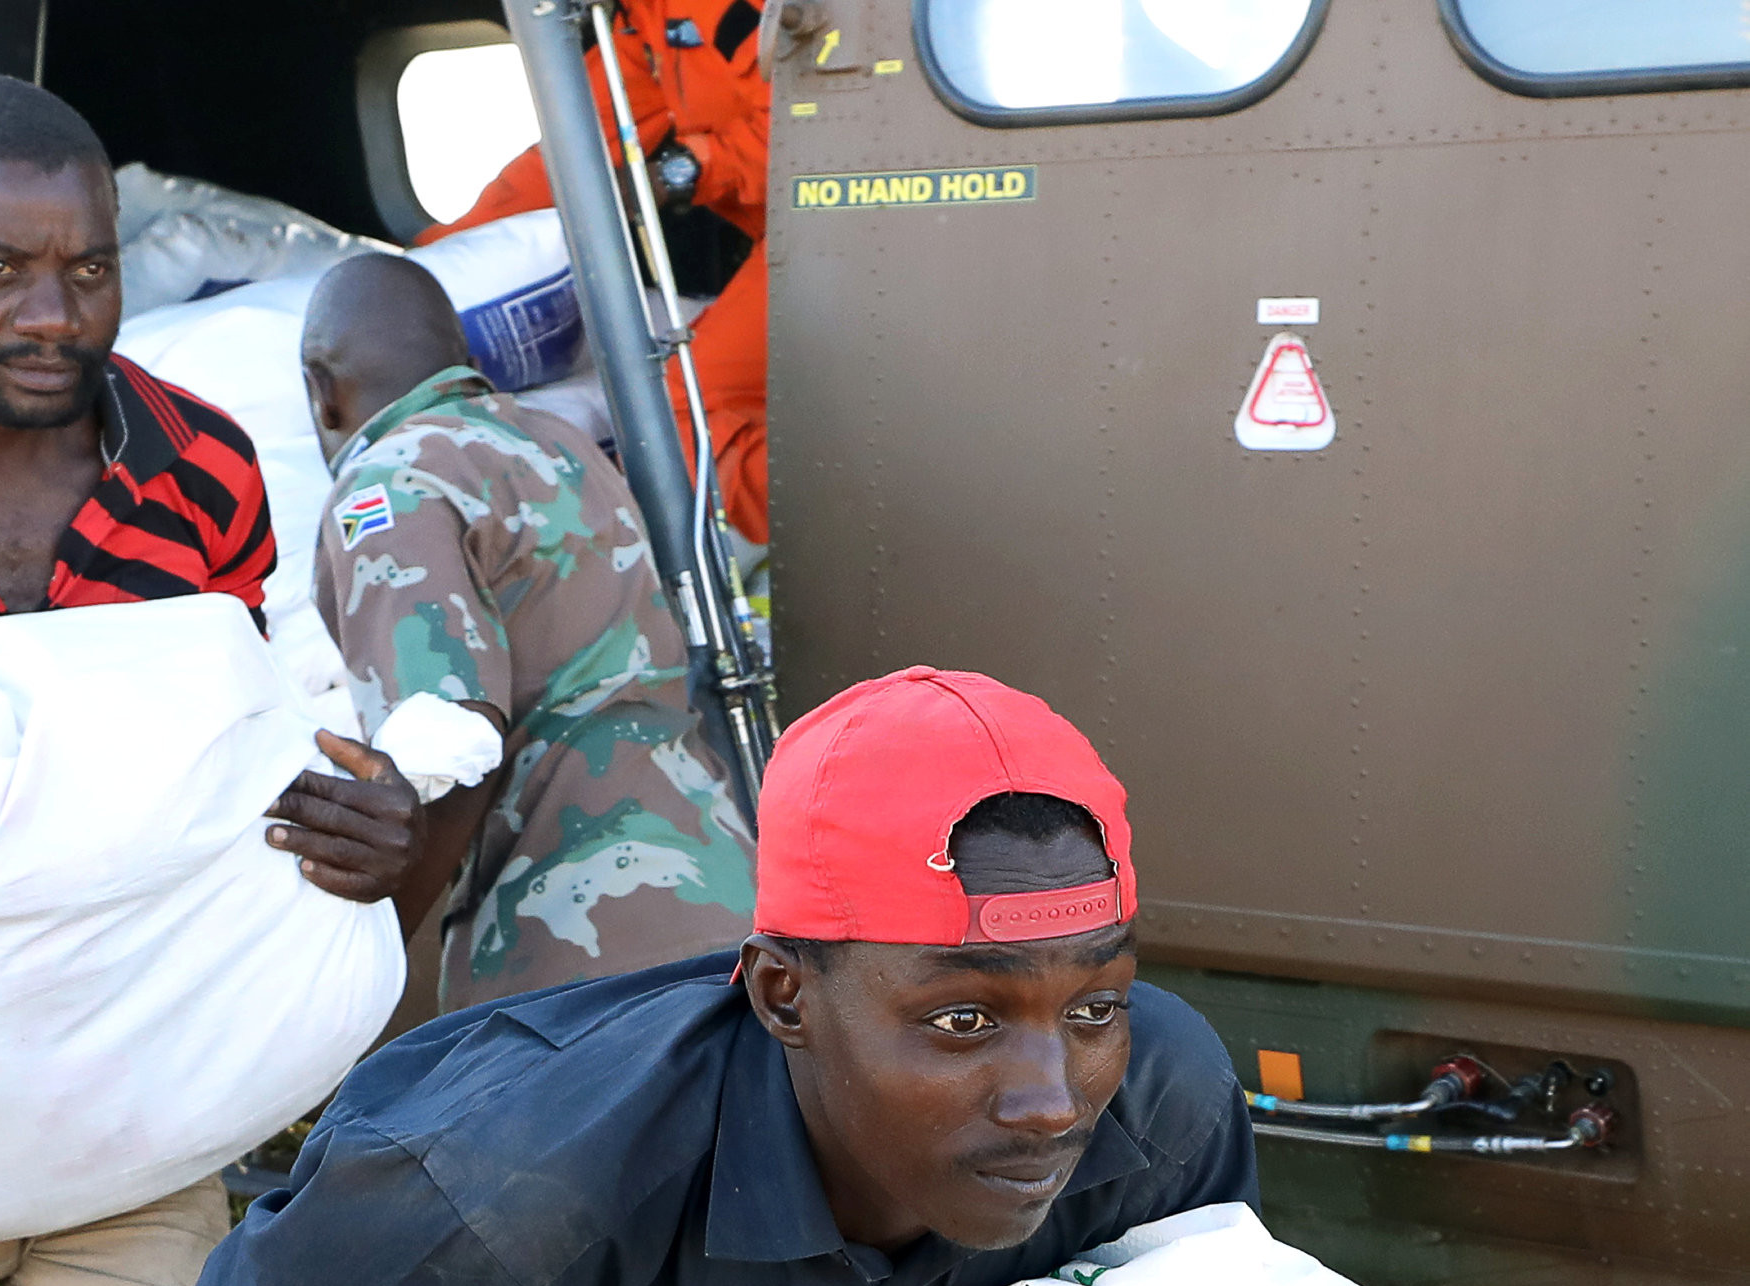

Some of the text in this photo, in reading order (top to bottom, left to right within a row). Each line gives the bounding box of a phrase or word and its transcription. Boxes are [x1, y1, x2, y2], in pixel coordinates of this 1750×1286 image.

[797, 171, 1026, 206] NO HAND HOLD
